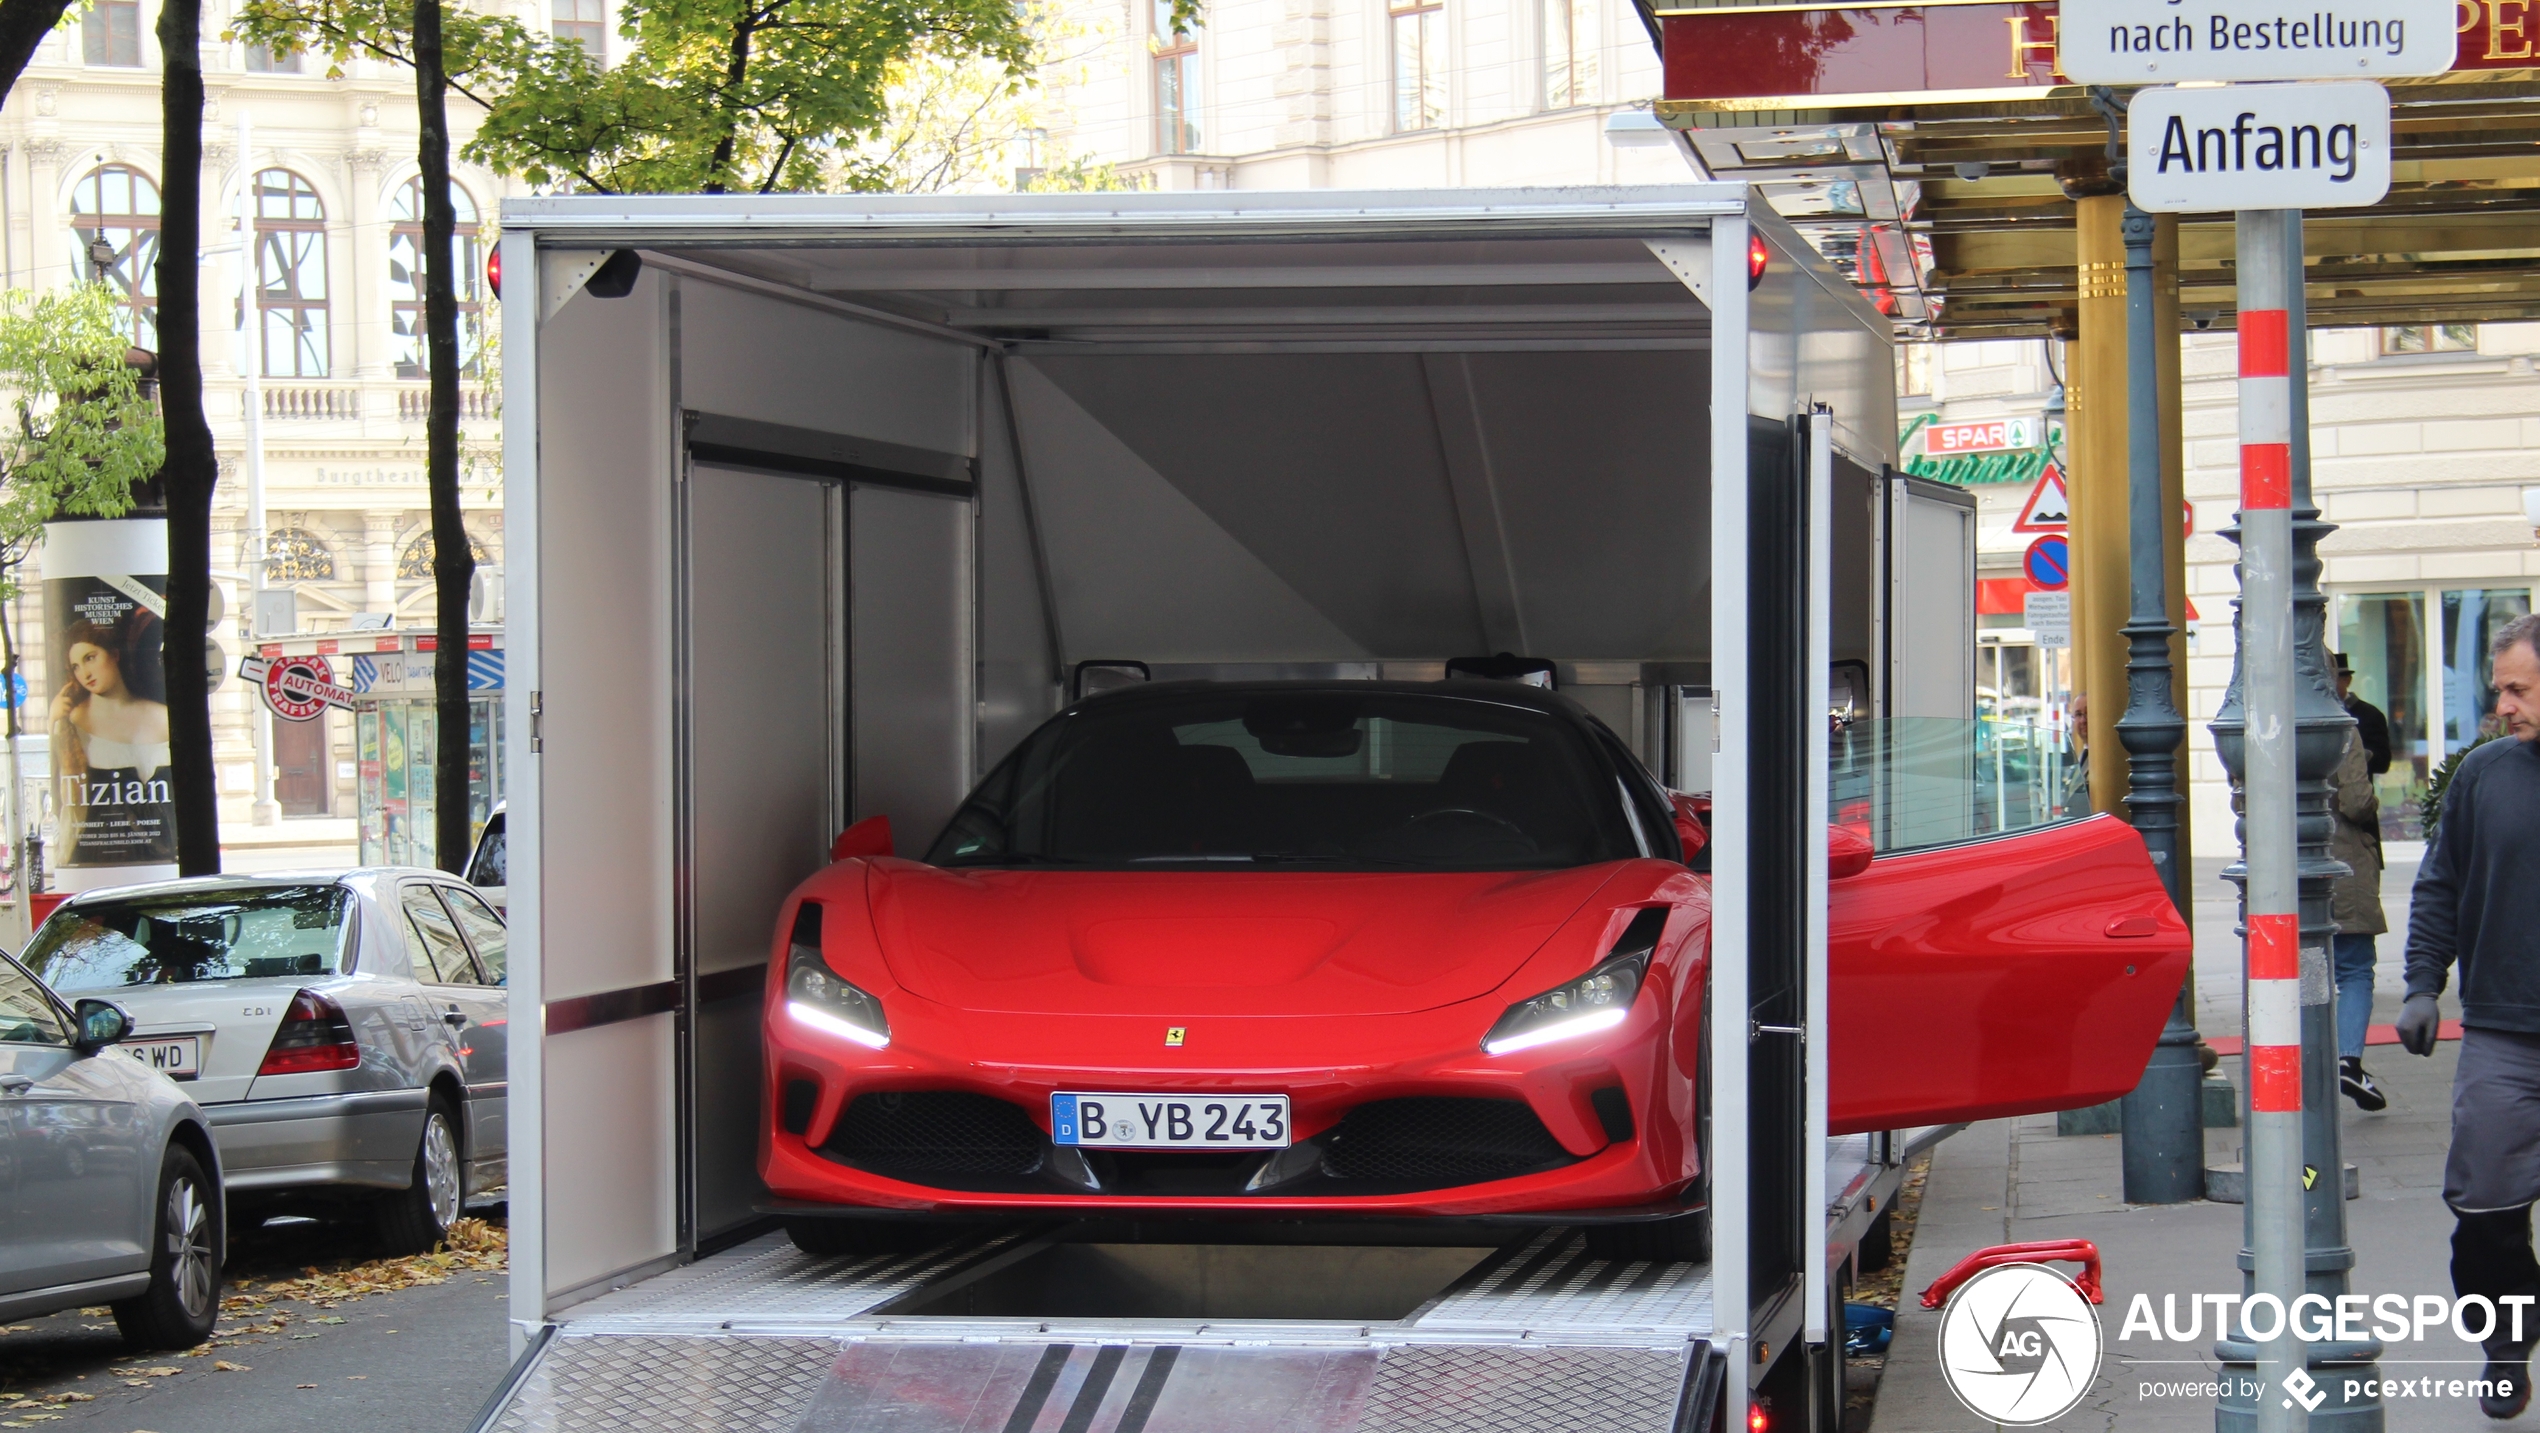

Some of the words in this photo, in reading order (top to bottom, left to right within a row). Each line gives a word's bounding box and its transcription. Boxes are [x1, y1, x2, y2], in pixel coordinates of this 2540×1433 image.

[2110, 16, 2193, 53] nach
[2210, 12, 2405, 56] Bestellung
[2157, 112, 2357, 183] Anfang
[1942, 425, 2005, 449] SPAR
[121, 579, 142, 596] Jetzt
[74, 602, 134, 612] HISTORISCHES
[88, 596, 117, 604] KUNST
[85, 610, 122, 619] MUSEUM
[2042, 634, 2065, 645] Ende
[276, 655, 328, 677] TABAK
[380, 662, 402, 684] VELO
[269, 681, 320, 716] TRAFIK
[284, 675, 354, 704] AUTOMAT
[60, 771, 172, 807] Tizian
[110, 820, 131, 828] LIEBE
[242, 1007, 272, 1017] CDI
[151, 1045, 183, 1068] WD
[1061, 1124, 1072, 1136] D
[1080, 1101, 1108, 1139] B
[1138, 1102, 1194, 1141] YB
[1204, 1103, 1285, 1141] 243
